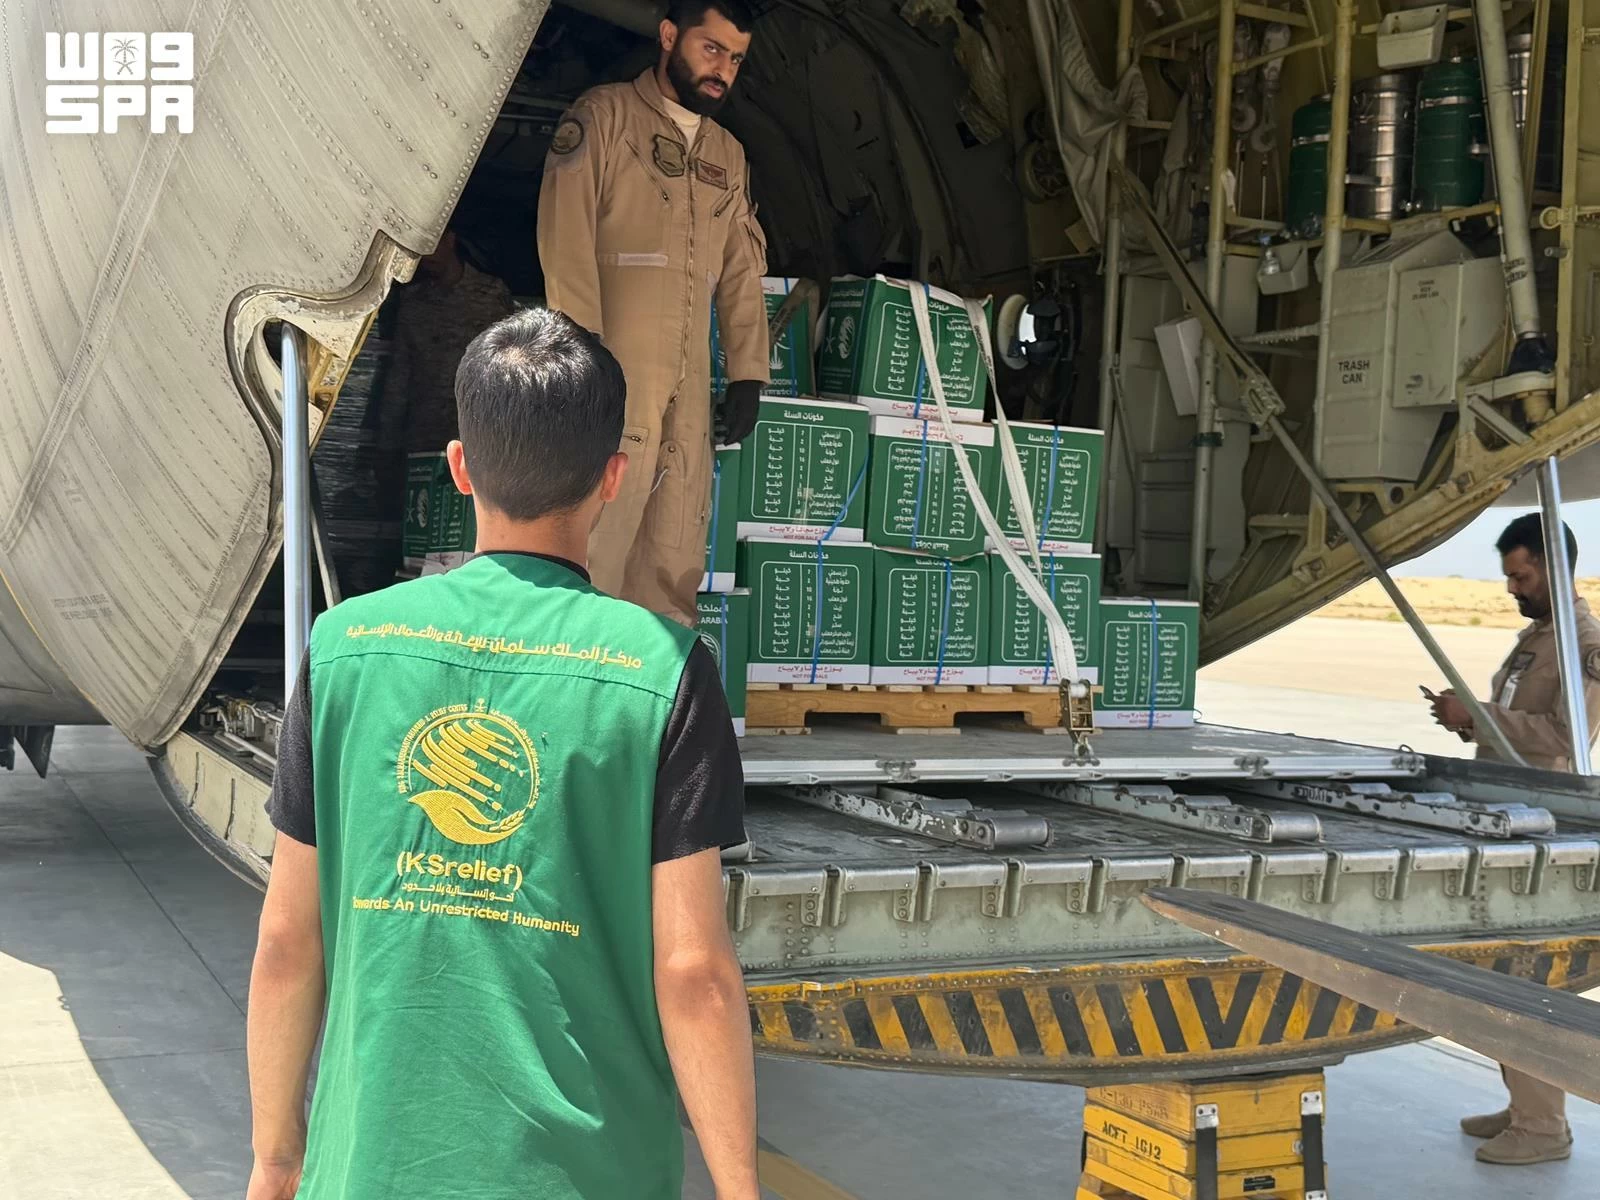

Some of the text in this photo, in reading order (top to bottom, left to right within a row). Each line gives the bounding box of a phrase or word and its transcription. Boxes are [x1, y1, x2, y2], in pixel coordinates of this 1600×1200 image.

[1338, 360, 1370, 371] TRASH
[1342, 374, 1362, 384] CAN
[784, 410, 824, 421] مكونات السلة
[789, 550, 807, 558] السلة
[489, 636, 551, 655] سلمان
[551, 642, 600, 660] الملك
[600, 648, 642, 669] مركز
[397, 851, 523, 891] (KSrelief)
[393, 897, 415, 912] An
[420, 900, 509, 922] Unrestricted
[512, 911, 580, 937] Humanity
